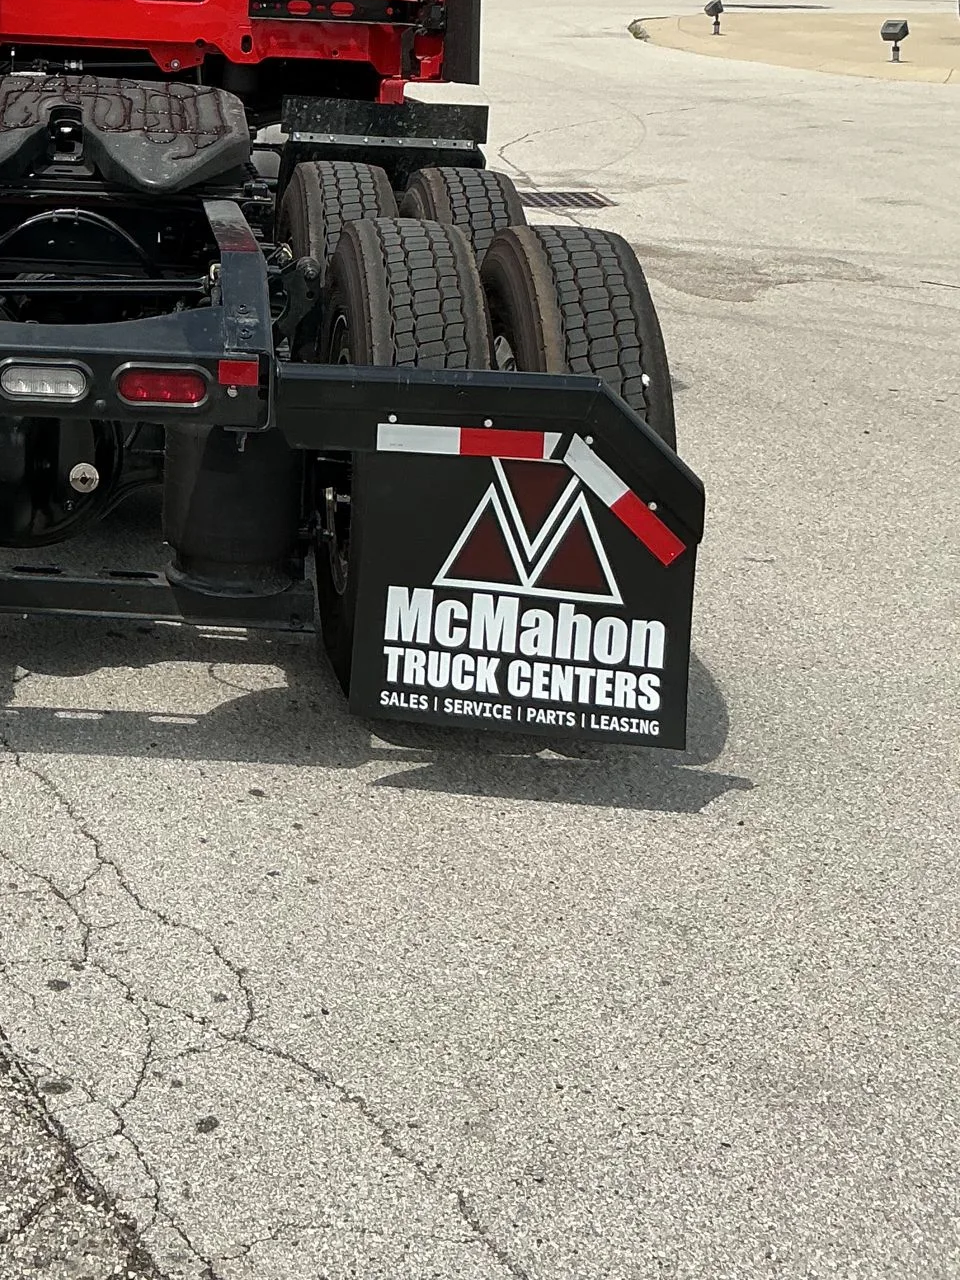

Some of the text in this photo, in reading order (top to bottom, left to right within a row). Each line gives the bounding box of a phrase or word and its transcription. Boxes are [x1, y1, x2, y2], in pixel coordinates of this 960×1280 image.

[383, 585, 666, 669] McMahon
[383, 646, 661, 712] TRUCK CENTERS
[380, 690, 660, 736] SALES SERVICE PARTS LEASING
